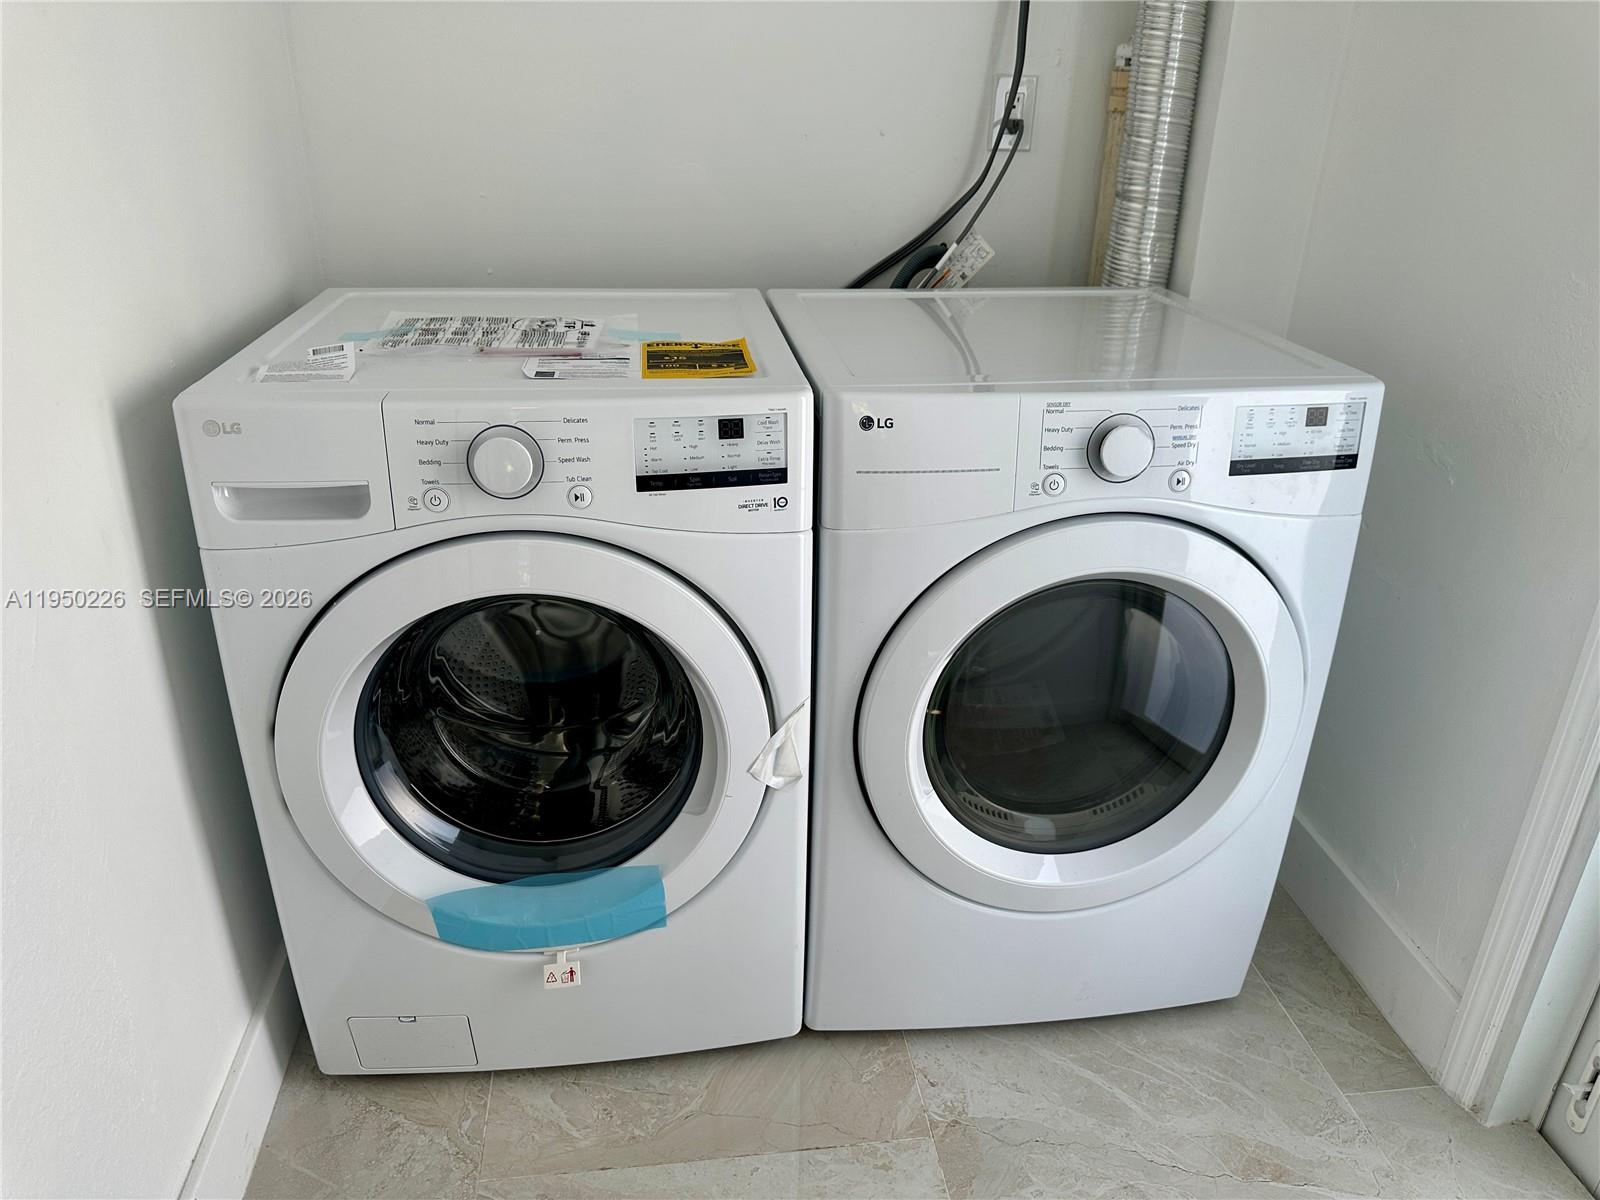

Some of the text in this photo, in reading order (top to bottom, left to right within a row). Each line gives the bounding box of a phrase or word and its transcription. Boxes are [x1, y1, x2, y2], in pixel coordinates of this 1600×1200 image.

[414, 418, 435, 426] Normal
[877, 417, 894, 429] LG
[222, 422, 242, 435] LG
[435, 438, 449, 446] Duty
[418, 459, 442, 467] Bedding
[558, 456, 575, 464] Speed
